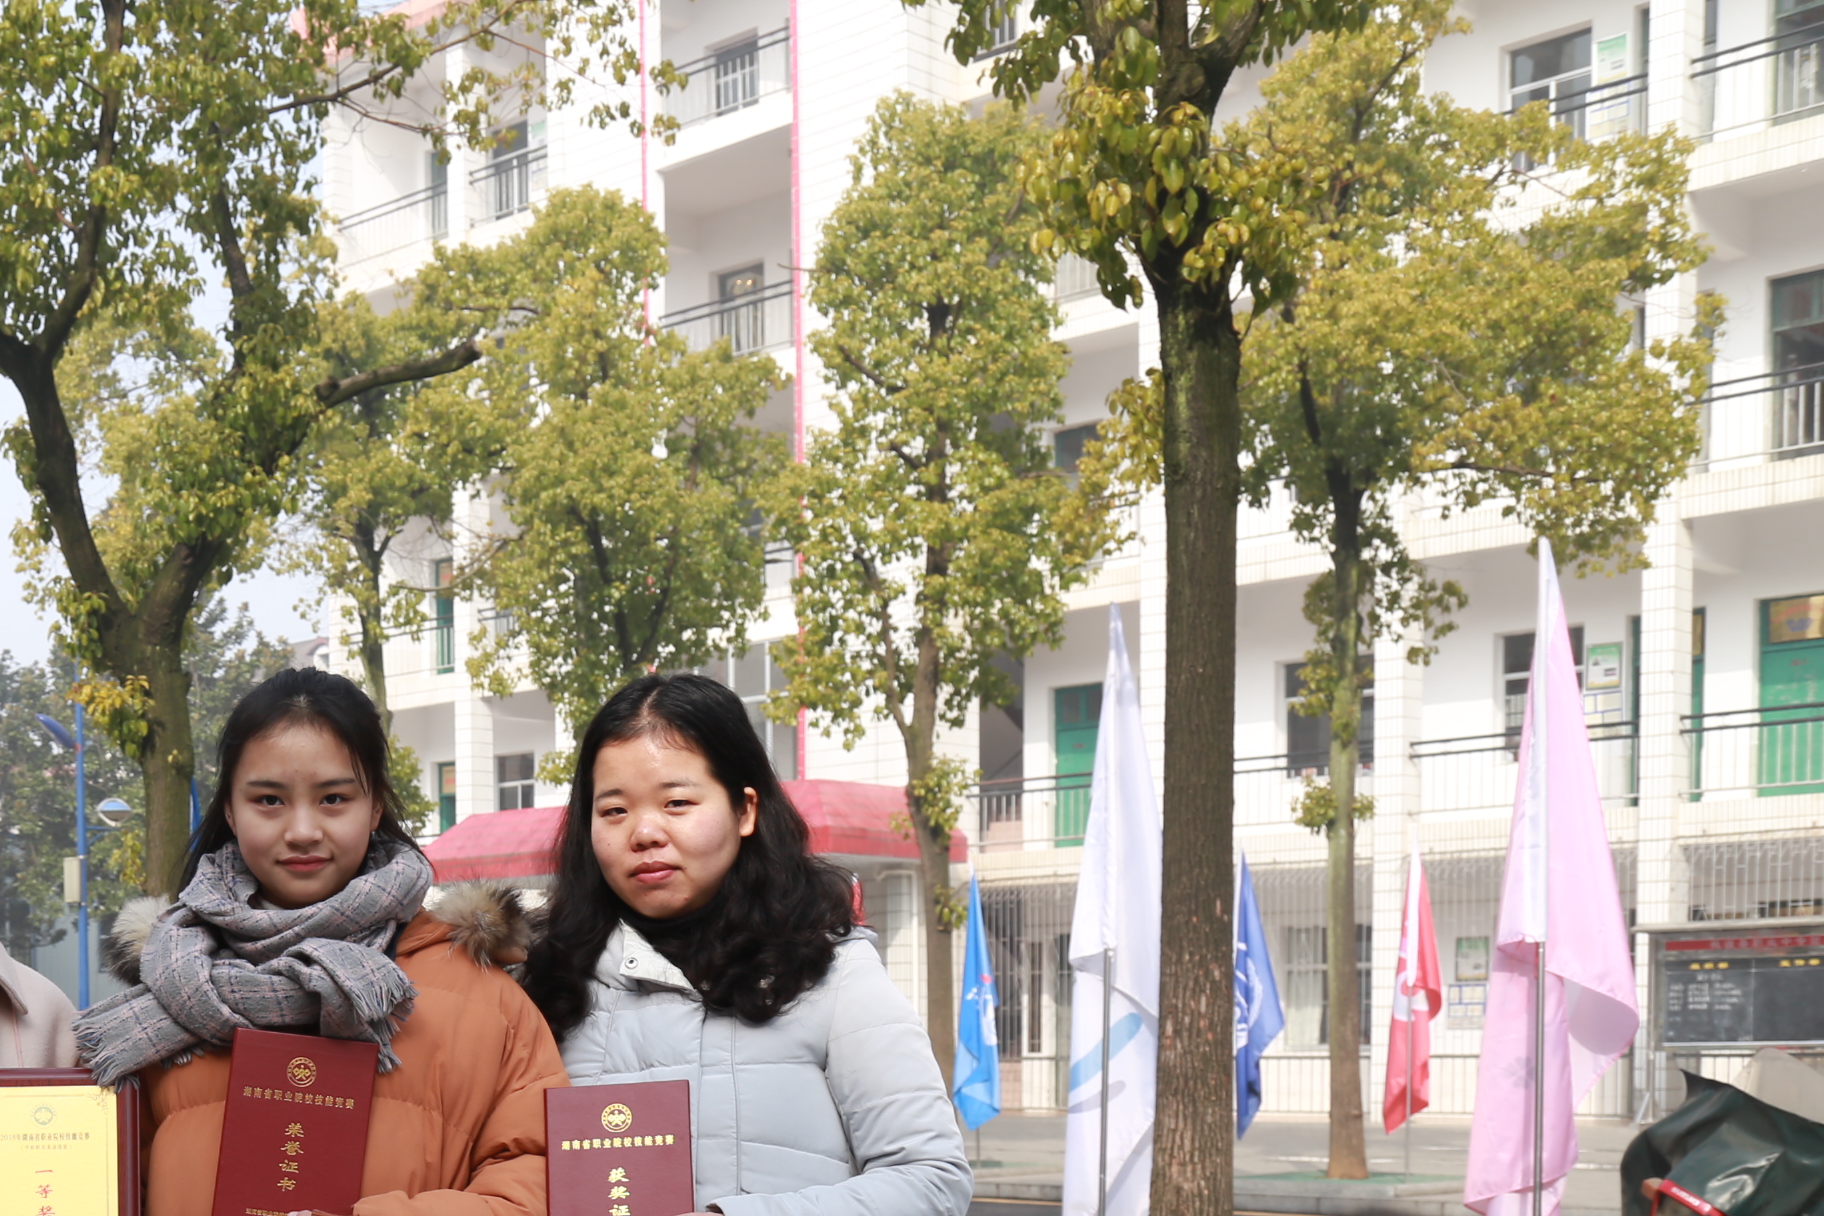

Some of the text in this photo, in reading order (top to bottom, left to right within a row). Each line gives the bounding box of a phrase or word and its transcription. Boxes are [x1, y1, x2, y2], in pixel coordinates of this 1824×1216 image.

[243, 1085, 355, 1110] 湖南省职业院校技能竞赛
[561, 1134, 675, 1151] 湖南省职业院校技能竞赛
[277, 1122, 305, 1192] 荣誉证书
